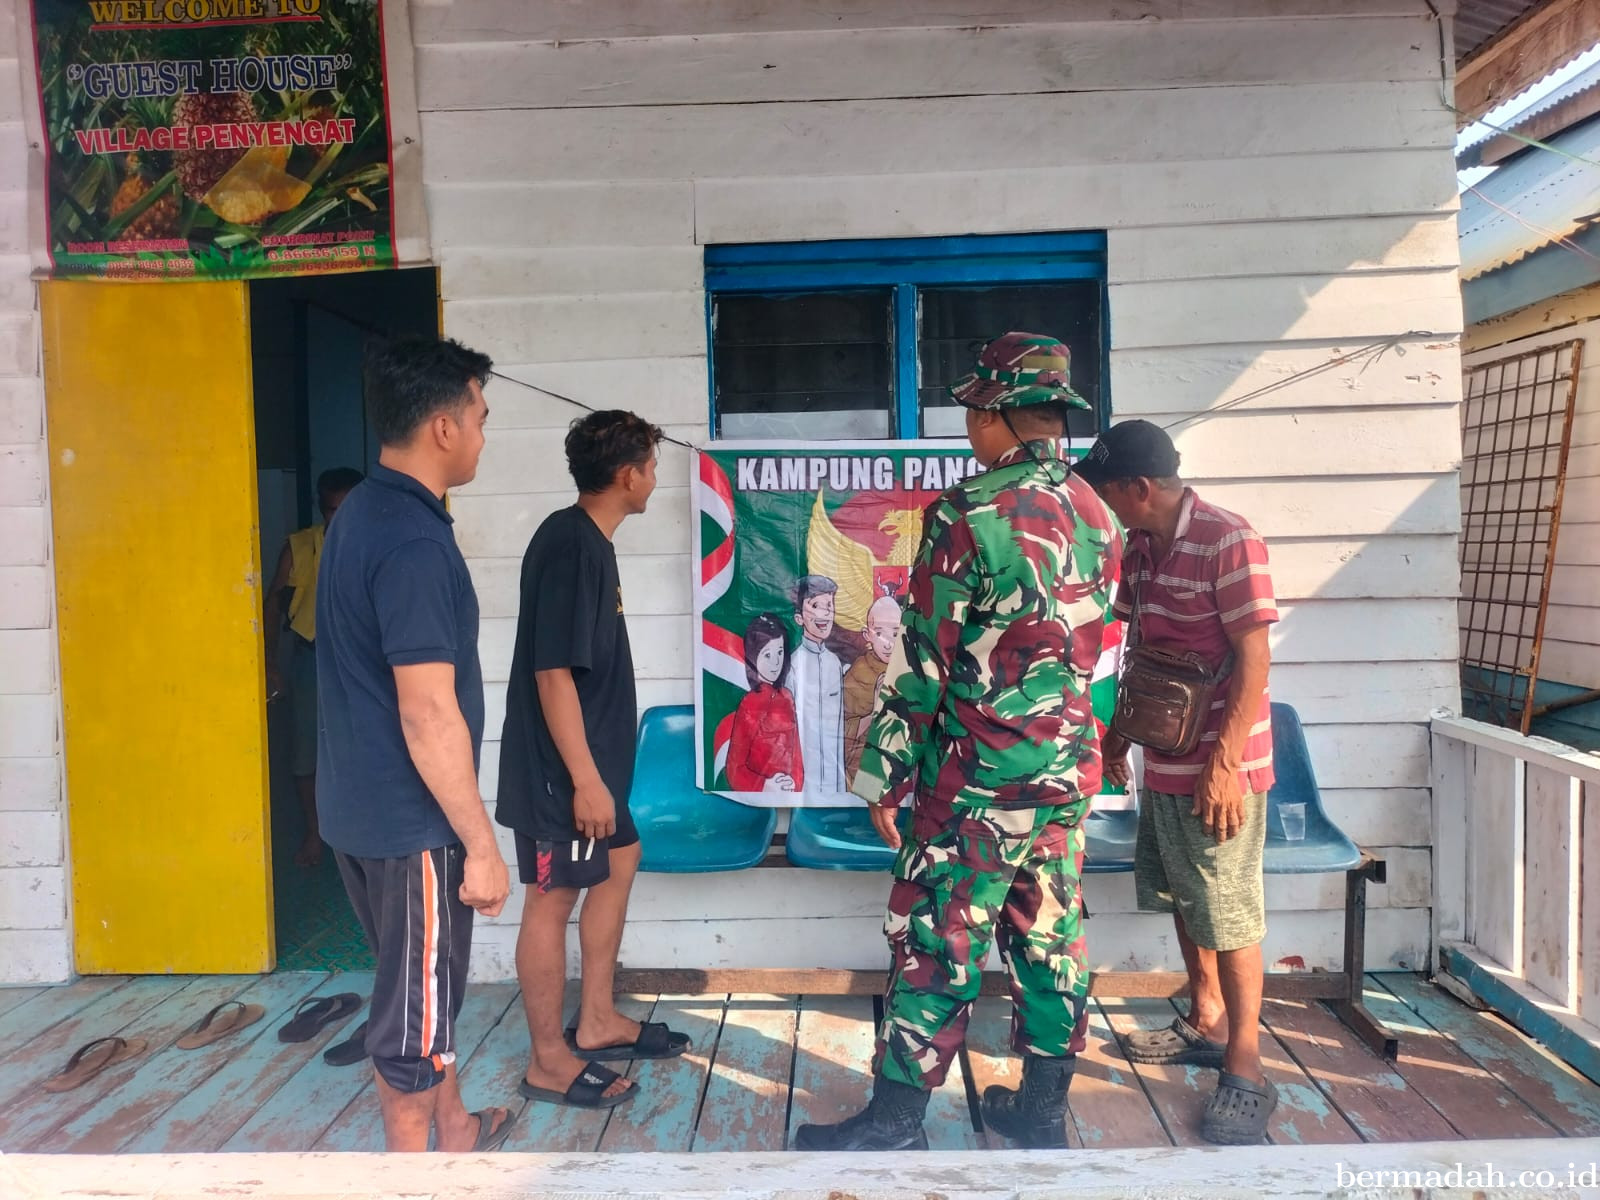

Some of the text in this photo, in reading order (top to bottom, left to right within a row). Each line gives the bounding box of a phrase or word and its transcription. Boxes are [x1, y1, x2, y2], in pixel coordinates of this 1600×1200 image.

[89, 0, 263, 23] WELCOME
[74, 119, 356, 155] VILLAGE PENYENGAT
[363, 245, 376, 257] N
[738, 456, 895, 491] KAMPUNG
